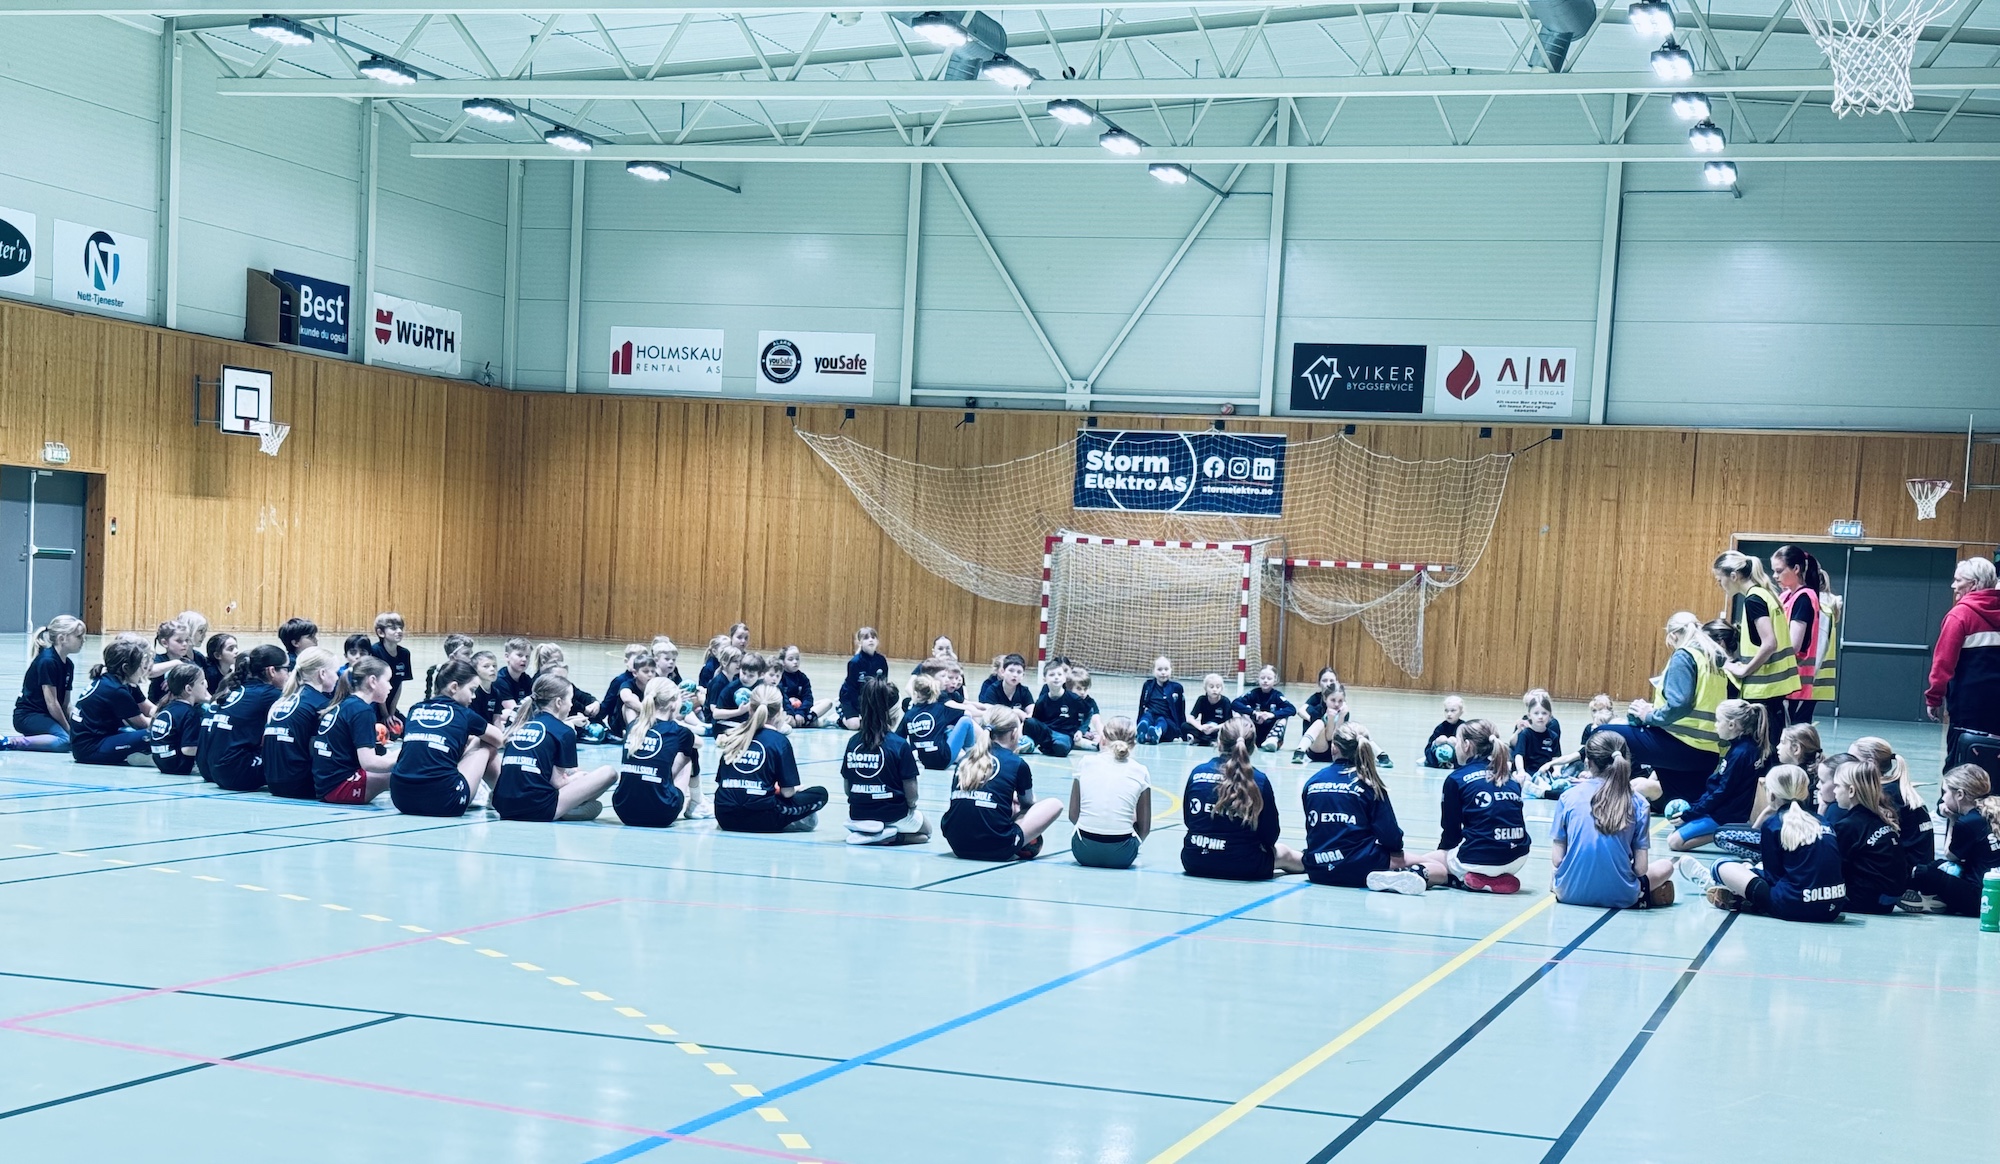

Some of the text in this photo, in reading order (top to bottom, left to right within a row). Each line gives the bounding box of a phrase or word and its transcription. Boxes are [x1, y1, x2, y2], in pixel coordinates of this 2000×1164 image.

[77, 290, 124, 307] Nett-Tjenester
[300, 284, 344, 325] Best
[321, 330, 329, 340] du
[396, 319, 455, 353] WÜRTH
[636, 344, 722, 361] HOLMSKAU
[636, 363, 721, 374] RENTAL AS
[769, 356, 793, 367] youSafe
[814, 353, 867, 374] youSafe
[1347, 366, 1415, 381] VIKER
[1346, 382, 1414, 392] BYGGSERVICE
[1085, 450, 1170, 473] Storm
[1084, 474, 1188, 492] Elektro AS
[1202, 485, 1274, 496] stormelektro.no
[847, 752, 880, 762] Storm
[1321, 812, 1357, 825] EXTRA
[1190, 834, 1227, 850] SOPHIE
[1314, 849, 1344, 864] NORA
